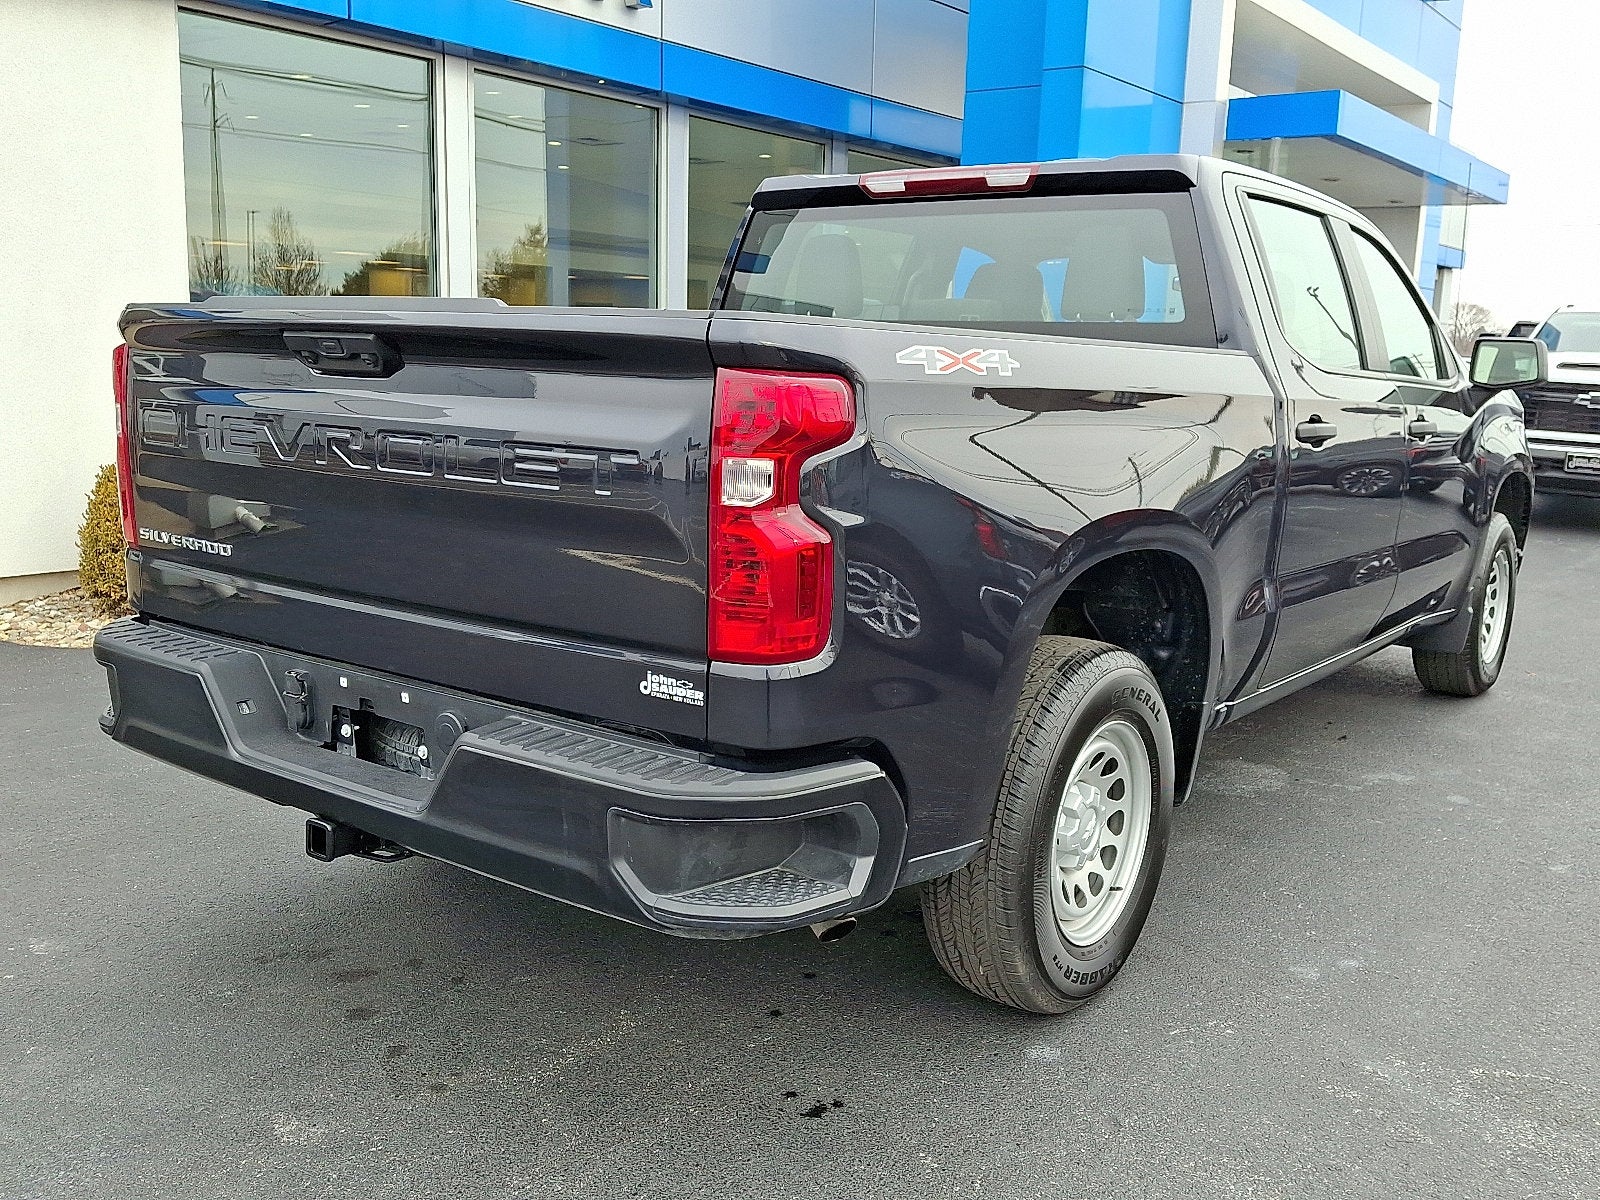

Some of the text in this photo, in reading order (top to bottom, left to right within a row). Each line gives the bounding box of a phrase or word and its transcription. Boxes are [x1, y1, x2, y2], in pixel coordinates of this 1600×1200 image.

[138, 402, 641, 496] CHEVROLET
[139, 527, 233, 556] SILVERADO
[651, 682, 704, 701] SAUDER
[1111, 686, 1161, 723] GENERAL
